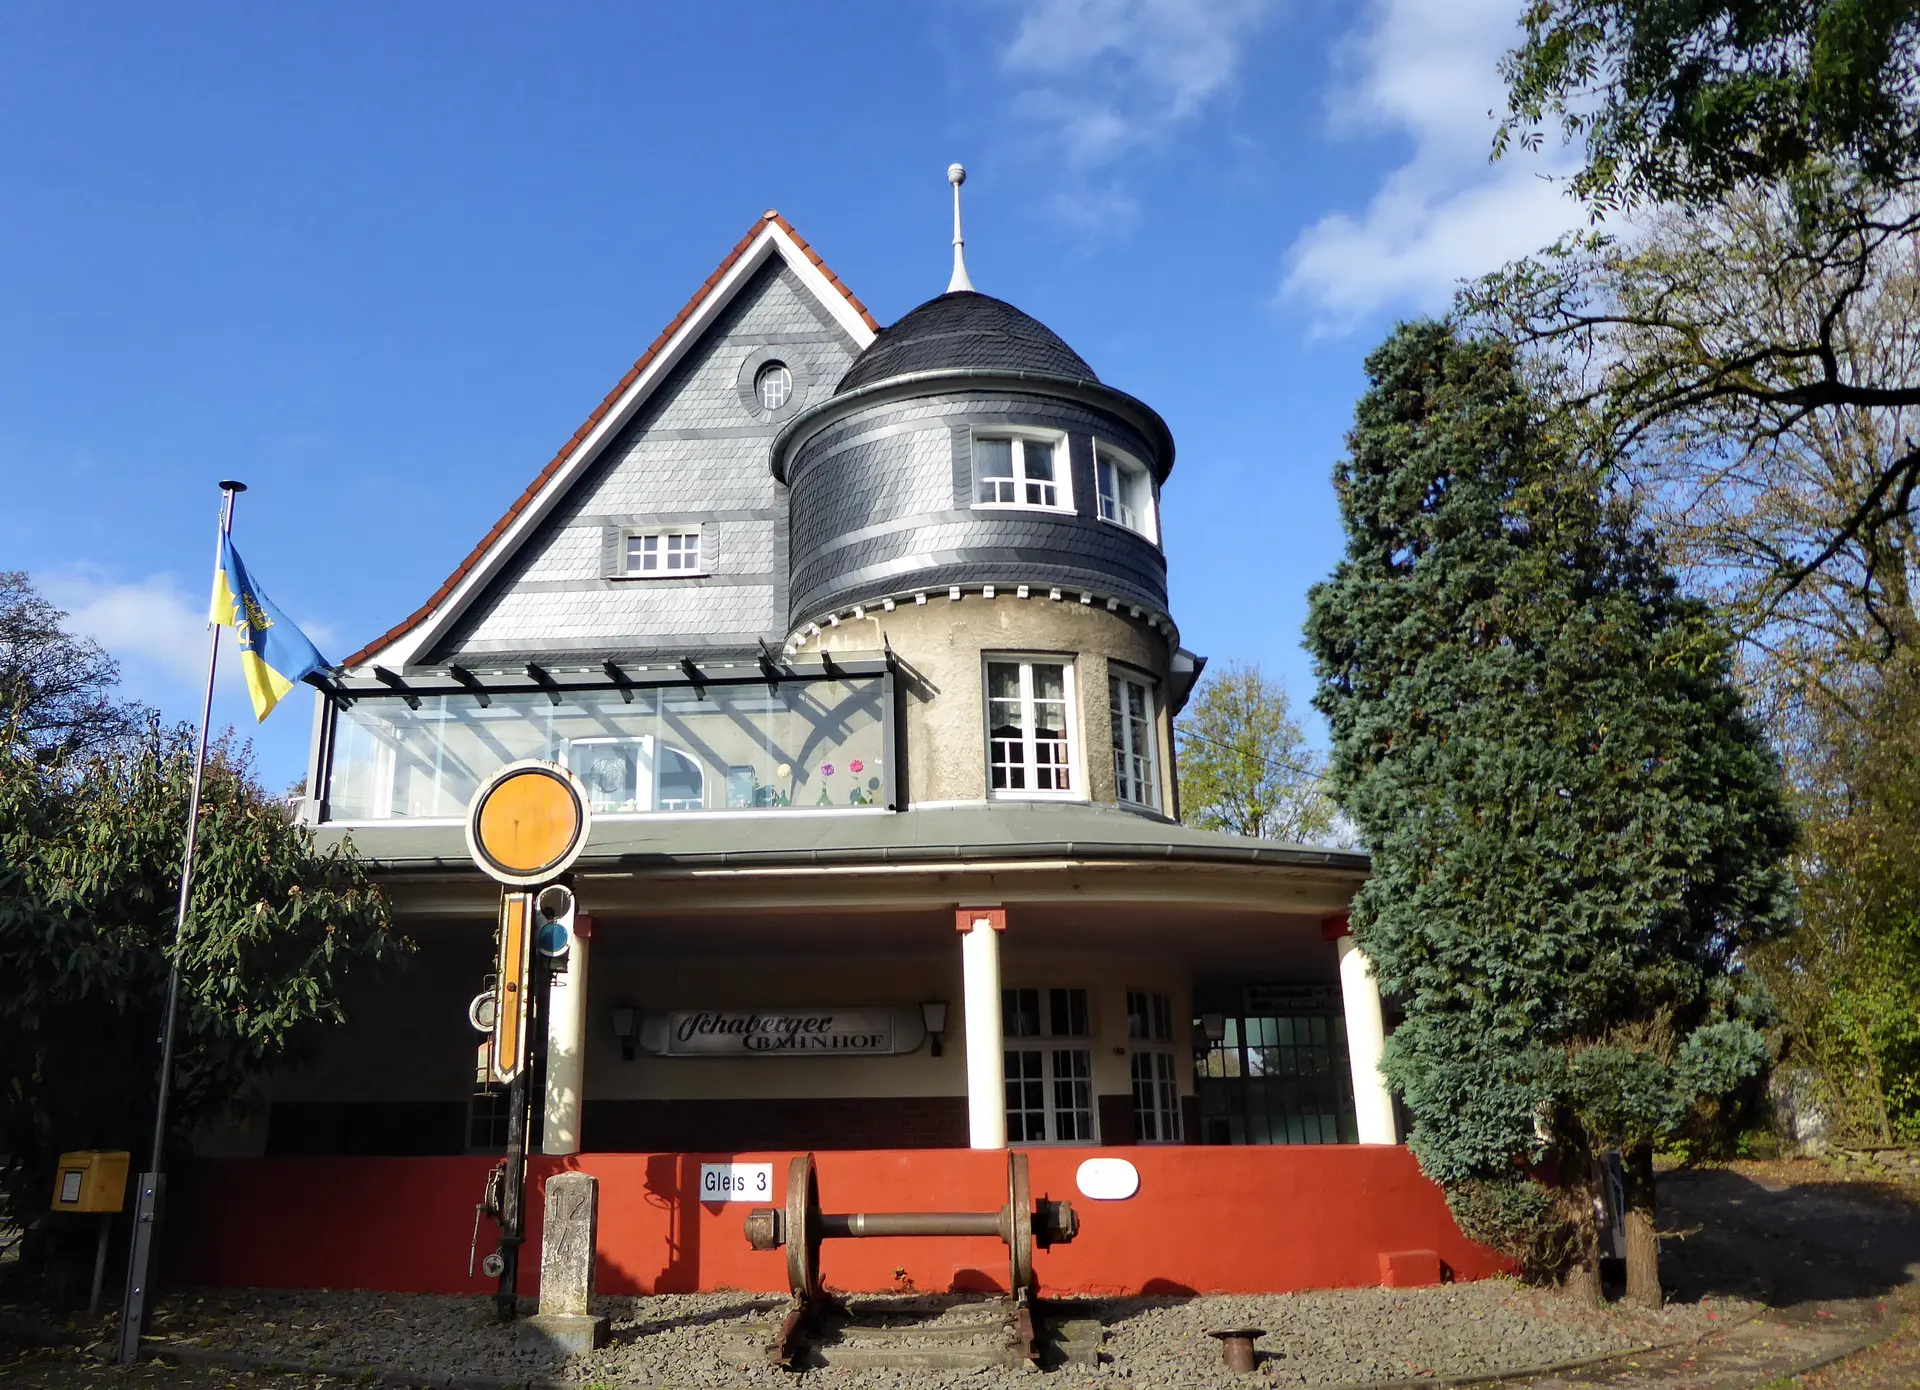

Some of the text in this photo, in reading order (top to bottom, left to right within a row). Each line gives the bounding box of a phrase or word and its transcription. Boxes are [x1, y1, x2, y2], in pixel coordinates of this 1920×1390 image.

[677, 1012, 833, 1041] Schaberger
[756, 1034, 883, 1049] BAHNHOF
[705, 1172, 767, 1191] Gleis 3
